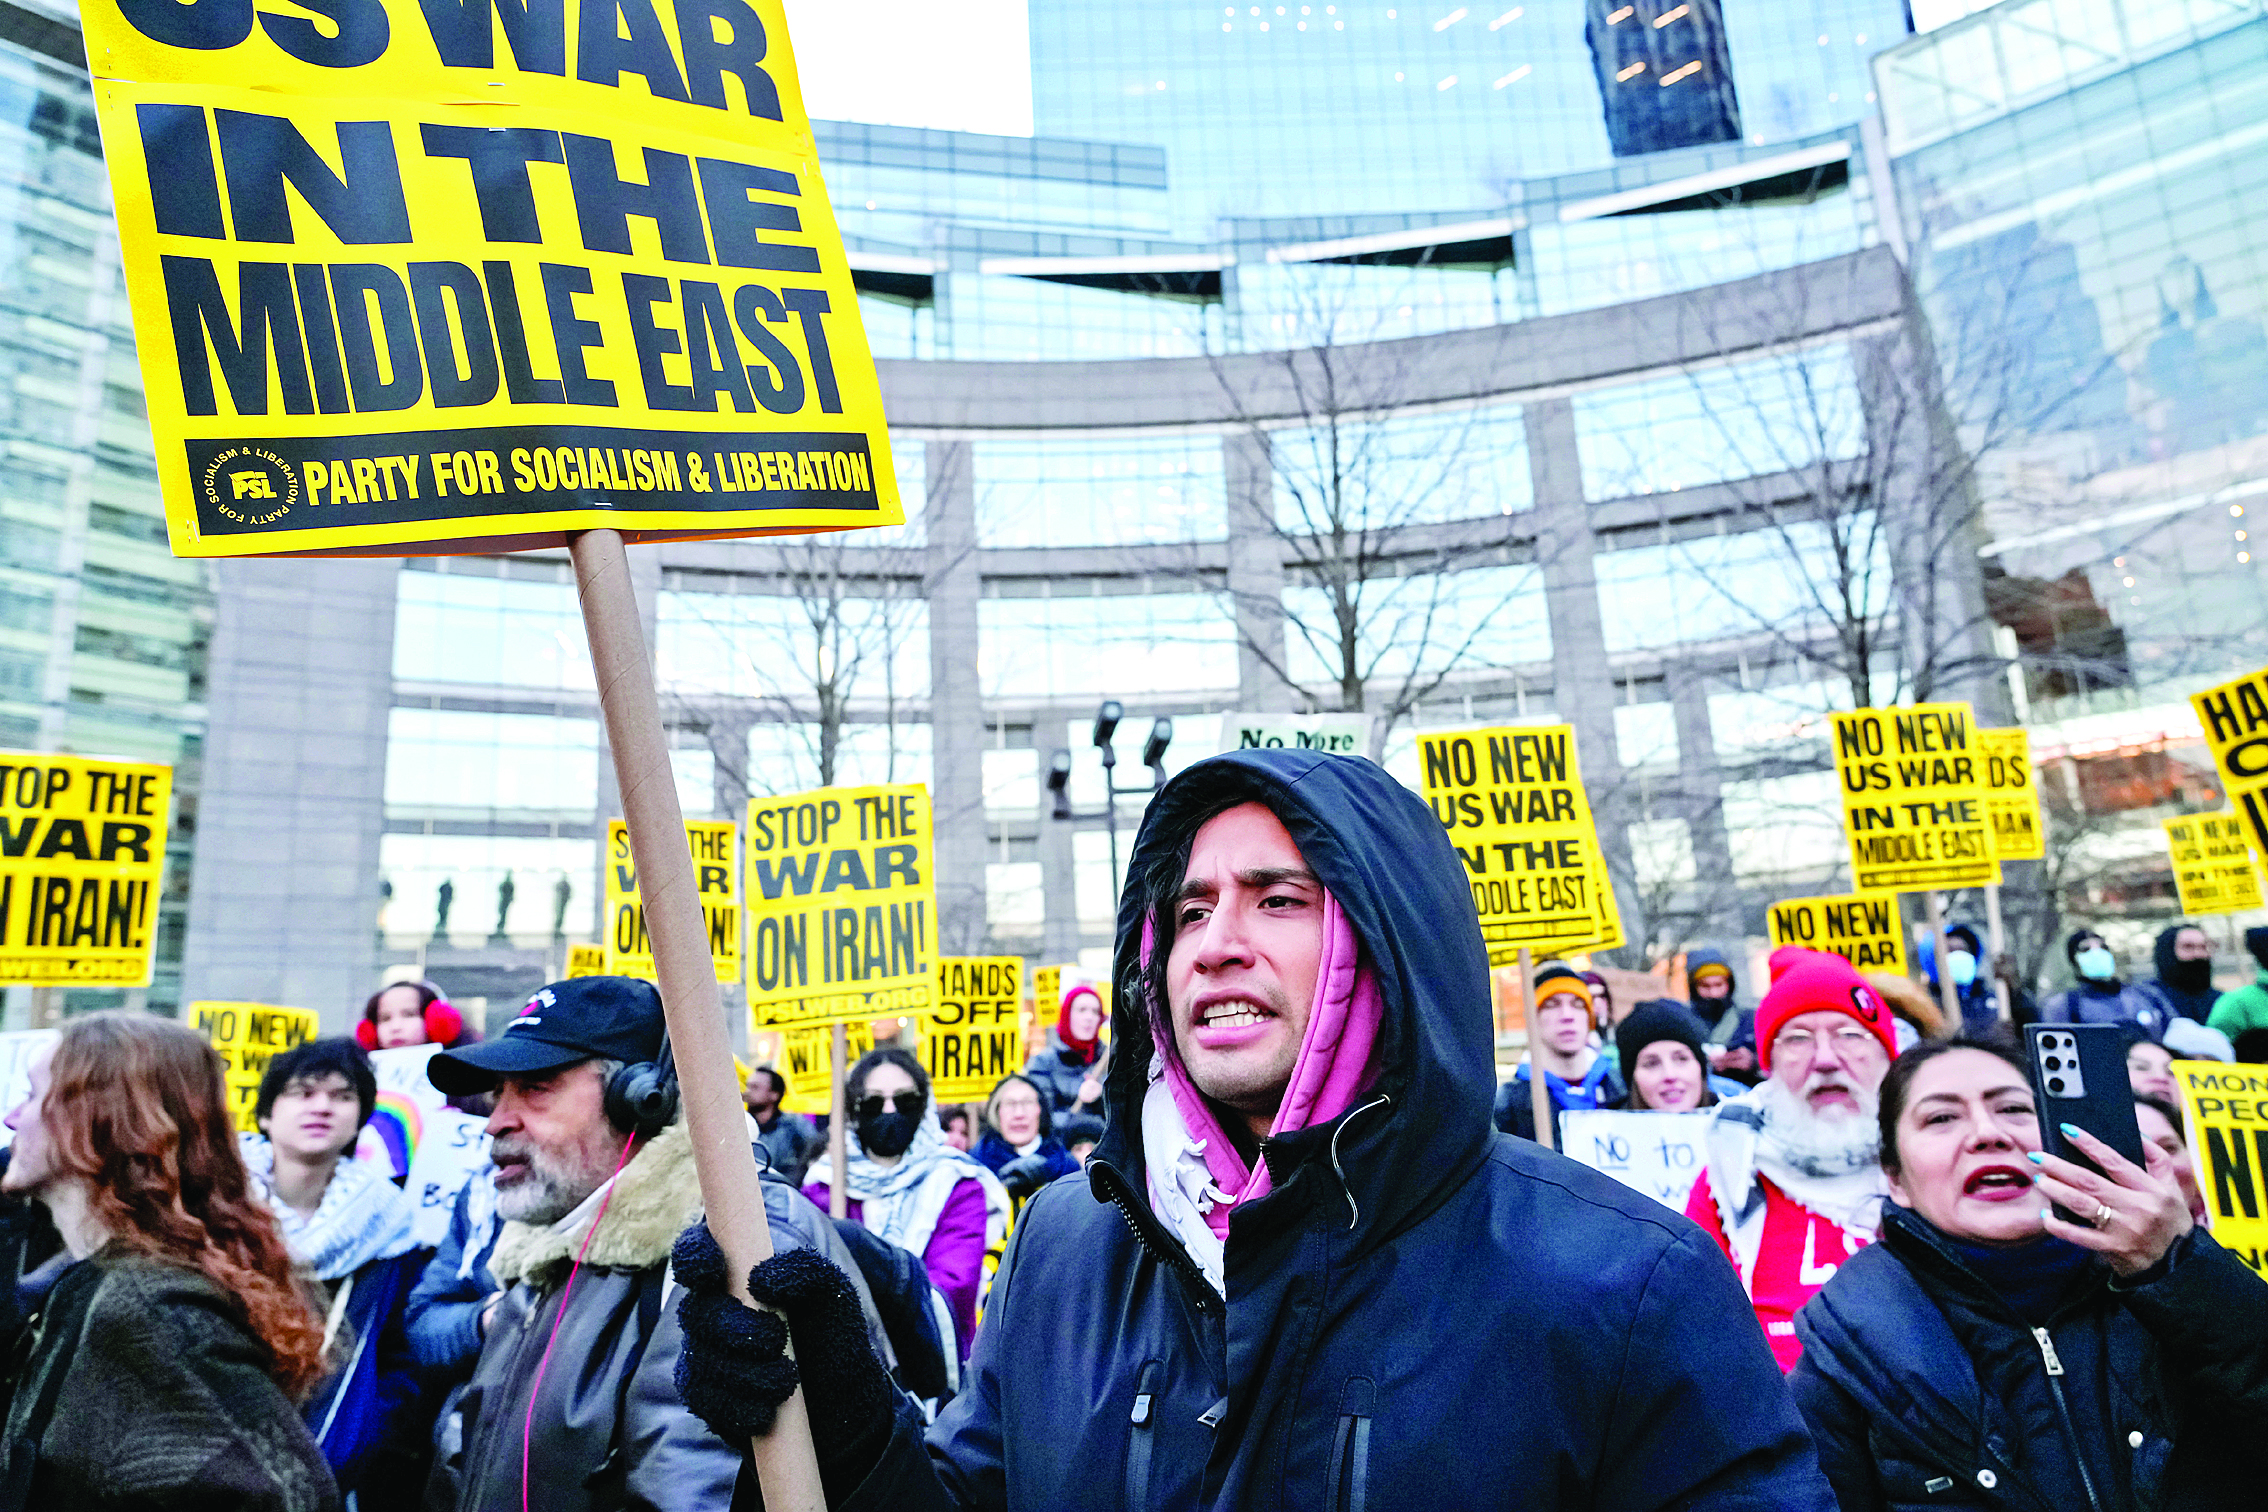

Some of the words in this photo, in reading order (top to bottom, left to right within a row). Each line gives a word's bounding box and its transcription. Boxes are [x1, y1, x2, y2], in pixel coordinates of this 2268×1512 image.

[418, 0, 783, 122] WAR
[136, 104, 413, 245] IN
[419, 122, 821, 273] THE
[161, 255, 618, 416] MIDDLE
[621, 272, 844, 416] EAST
[241, 446, 252, 456] &
[203, 448, 239, 504] SOCIALISM
[230, 478, 278, 500] PSL
[255, 447, 299, 505] LIBERATION
[302, 454, 420, 506] PARTY
[430, 449, 505, 498] FOR
[509, 446, 683, 494] SOCIALISM
[686, 455, 711, 493] &
[712, 450, 871, 492] LIBERATION
[218, 503, 245, 523] FOR
[250, 504, 290, 525] PARTY
[1839, 717, 1884, 759] NO
[1896, 711, 1966, 754] NEW
[1424, 738, 1477, 789] NO
[1488, 734, 1567, 785] NEW
[1845, 762, 1892, 793] US
[1897, 756, 1975, 788] WAR
[87, 770, 157, 815] THE
[1489, 789, 1576, 825] WAR
[1851, 806, 1895, 831] IN
[1901, 799, 1982, 826] THE
[755, 800, 841, 851] STOP
[853, 795, 917, 841] THE
[755, 844, 921, 900] WAR
[1456, 845, 1487, 874] N
[1492, 839, 1584, 873] THE
[27, 876, 148, 948] IRAN!
[1473, 878, 1531, 916] DDLE
[1536, 875, 1586, 912] EAST
[1774, 907, 1815, 943] NO
[1825, 900, 1889, 939] NEW
[757, 912, 808, 992] ON
[822, 900, 928, 984] IRAN!
[756, 985, 929, 1025] PSLWEB.ORG
[932, 1000, 1015, 1026] OFF
[931, 1032, 1016, 1078] IRAN!
[1594, 1133, 1631, 1166] NO
